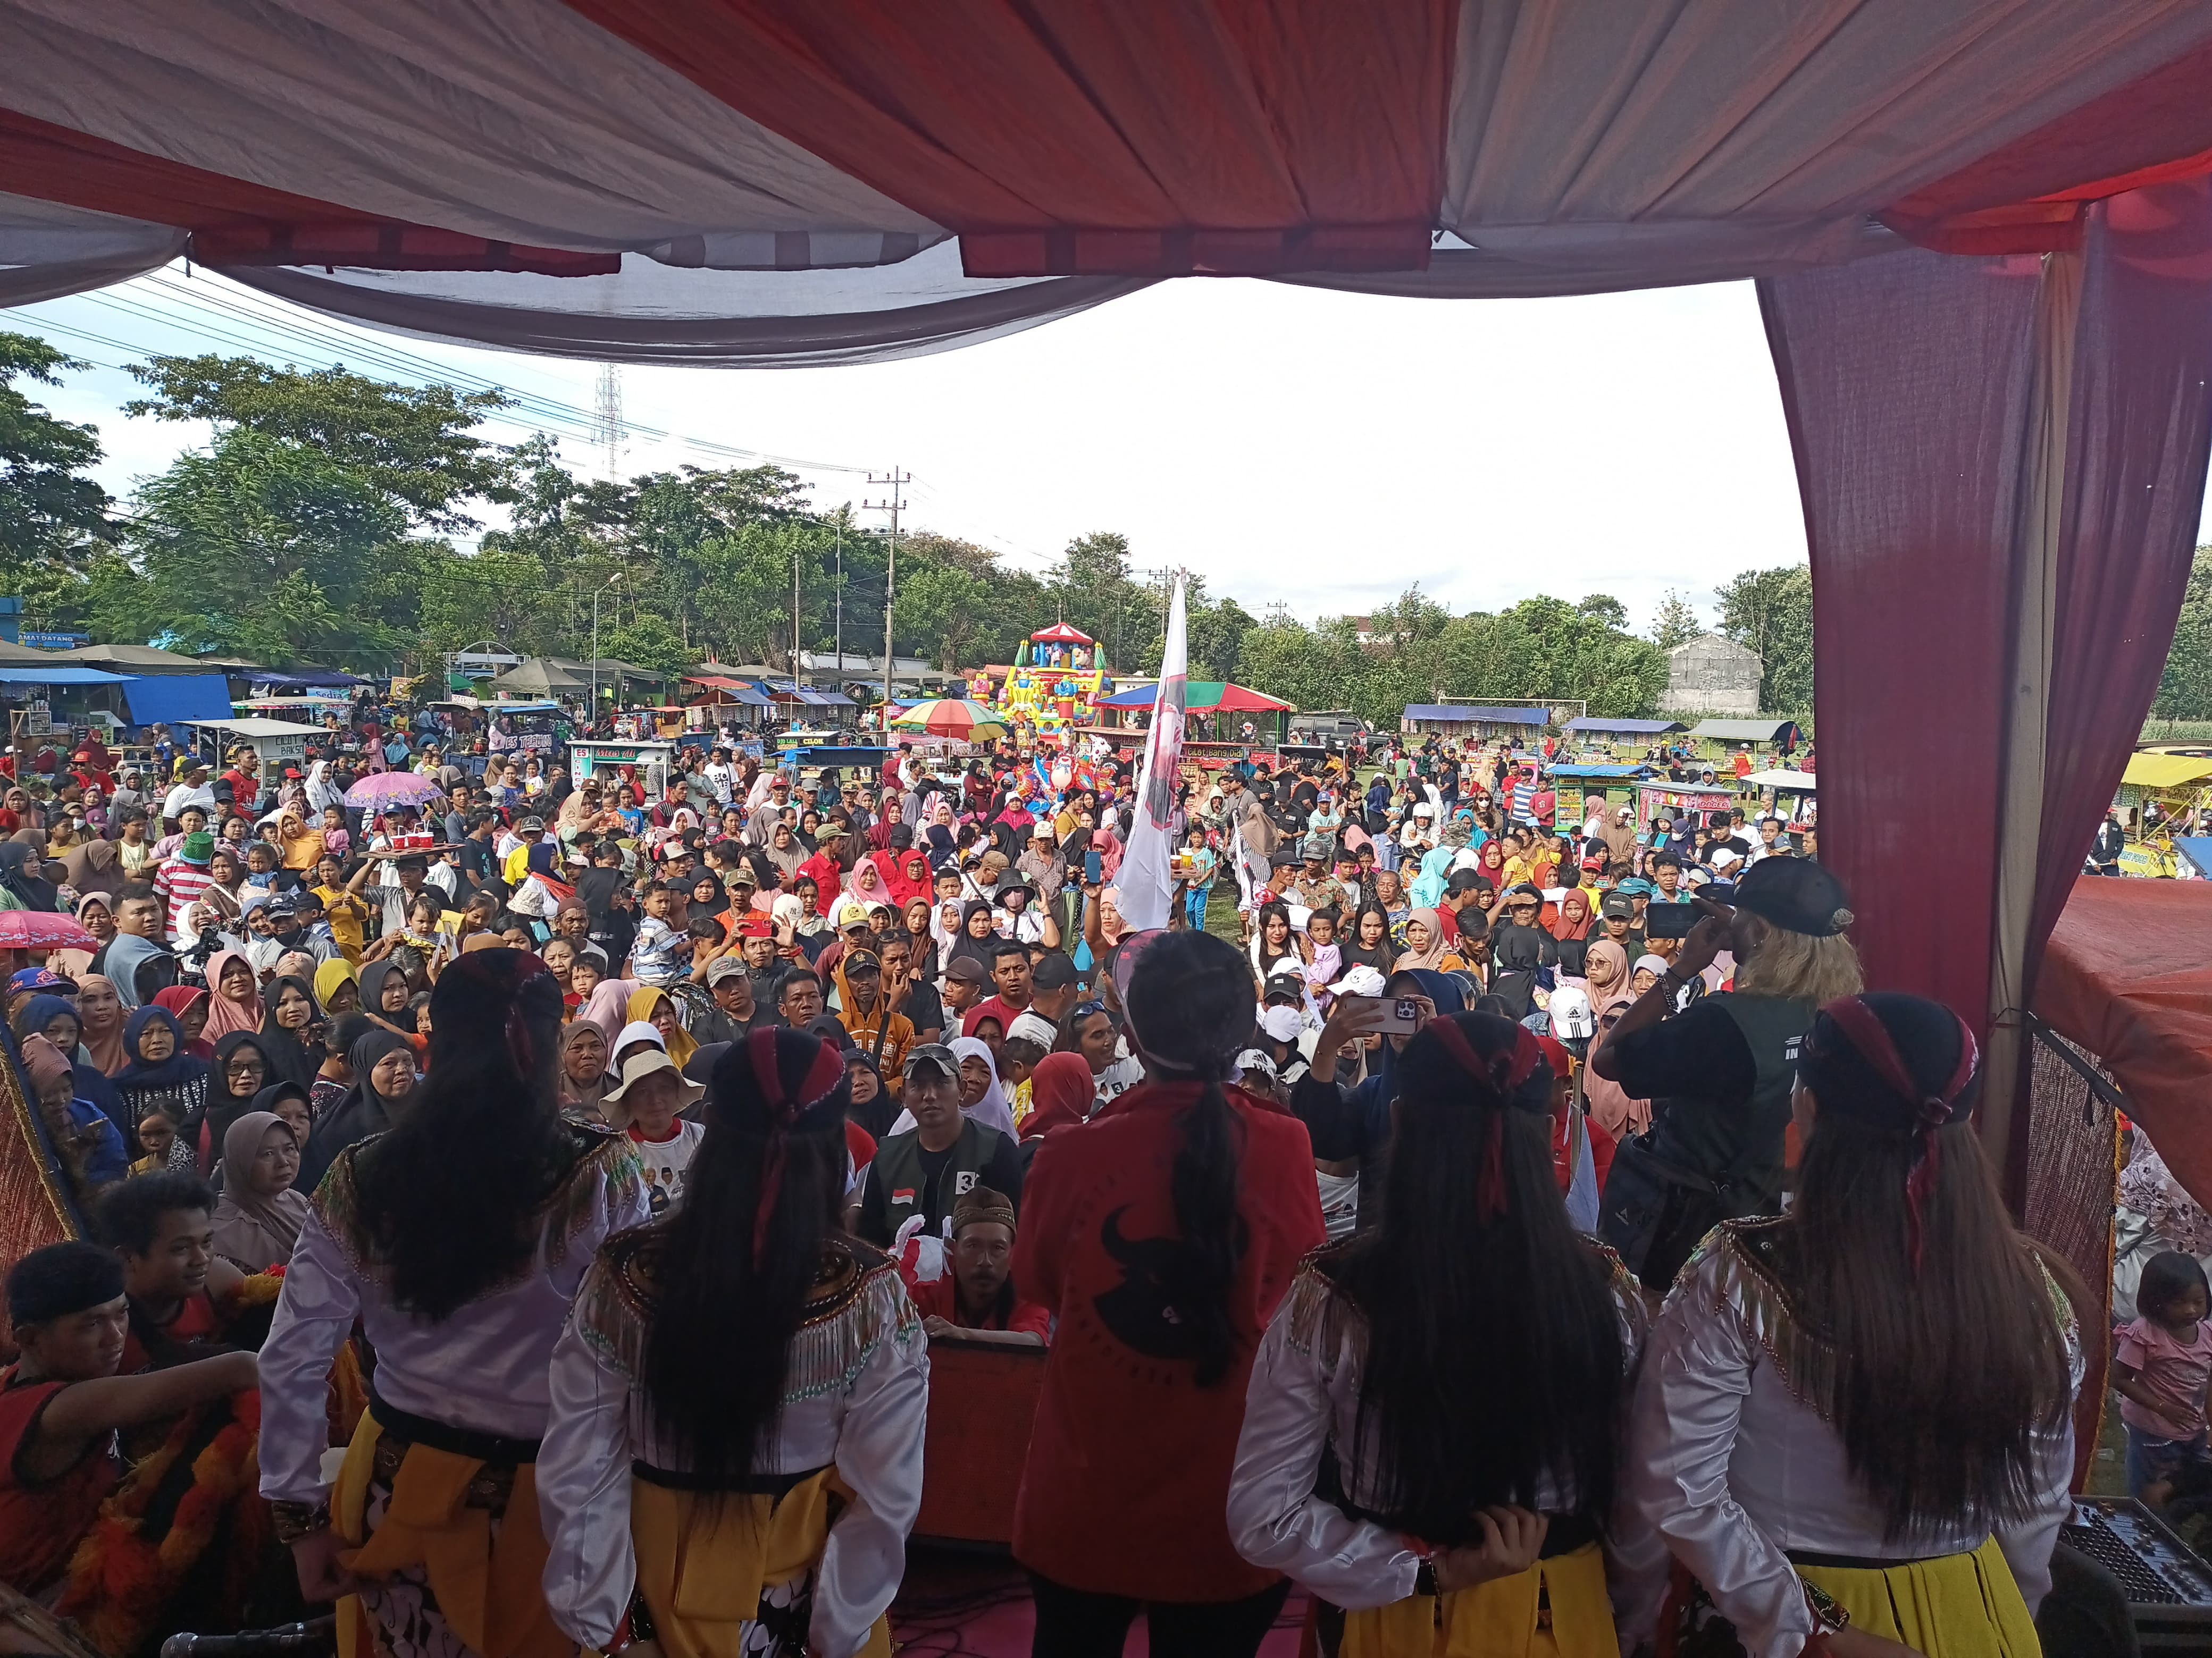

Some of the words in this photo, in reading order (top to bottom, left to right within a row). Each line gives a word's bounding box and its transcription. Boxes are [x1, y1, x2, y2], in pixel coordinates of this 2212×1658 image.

[315, 691, 343, 700] Sedia
[281, 745, 304, 755] BAKSO
[1209, 748, 1227, 757] Bang
[1229, 748, 1243, 758] Didi
